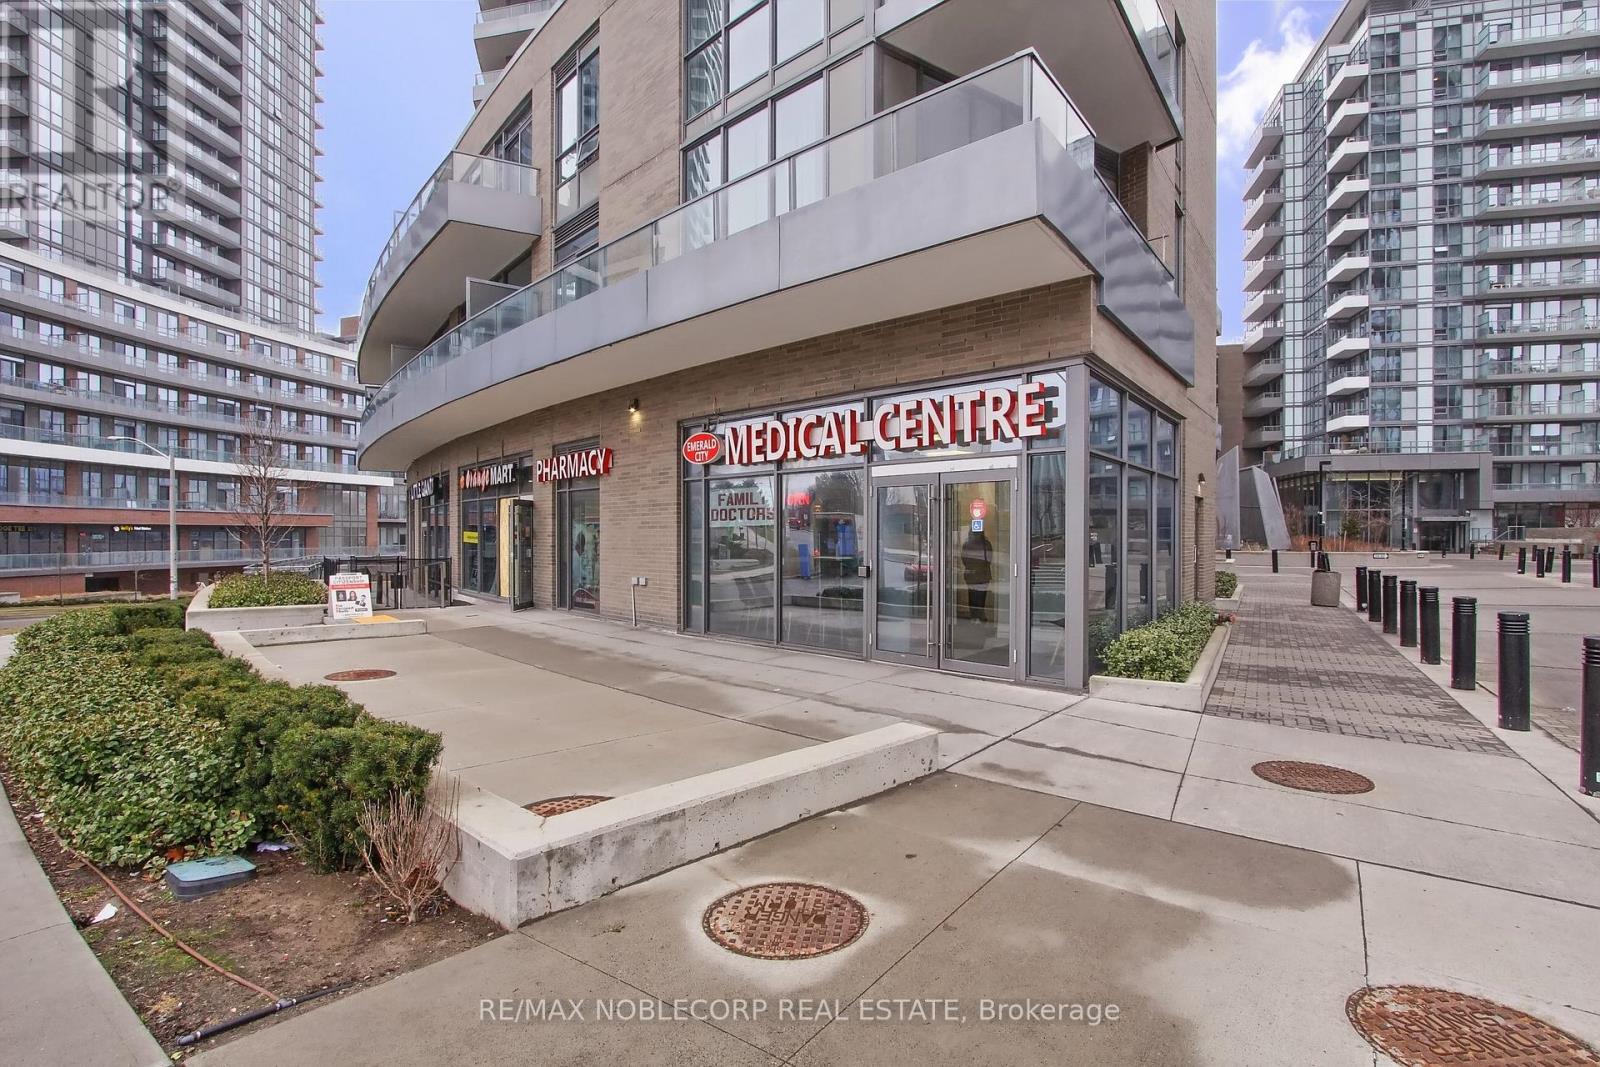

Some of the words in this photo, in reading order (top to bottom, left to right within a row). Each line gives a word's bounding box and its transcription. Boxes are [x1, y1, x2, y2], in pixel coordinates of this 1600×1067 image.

[724, 409, 865, 465] MEDICAL
[873, 382, 1046, 451] CENTRE
[686, 439, 717, 451] EMERALD
[694, 451, 709, 462] CITY
[490, 463, 514, 486] MART
[536, 448, 607, 482] PHARMACY
[711, 506, 775, 521] DOCTORS
[744, 909, 828, 926] DANGER
[1385, 1010, 1501, 1035] SANITARY
[1417, 1032, 1541, 1057] DANGER
